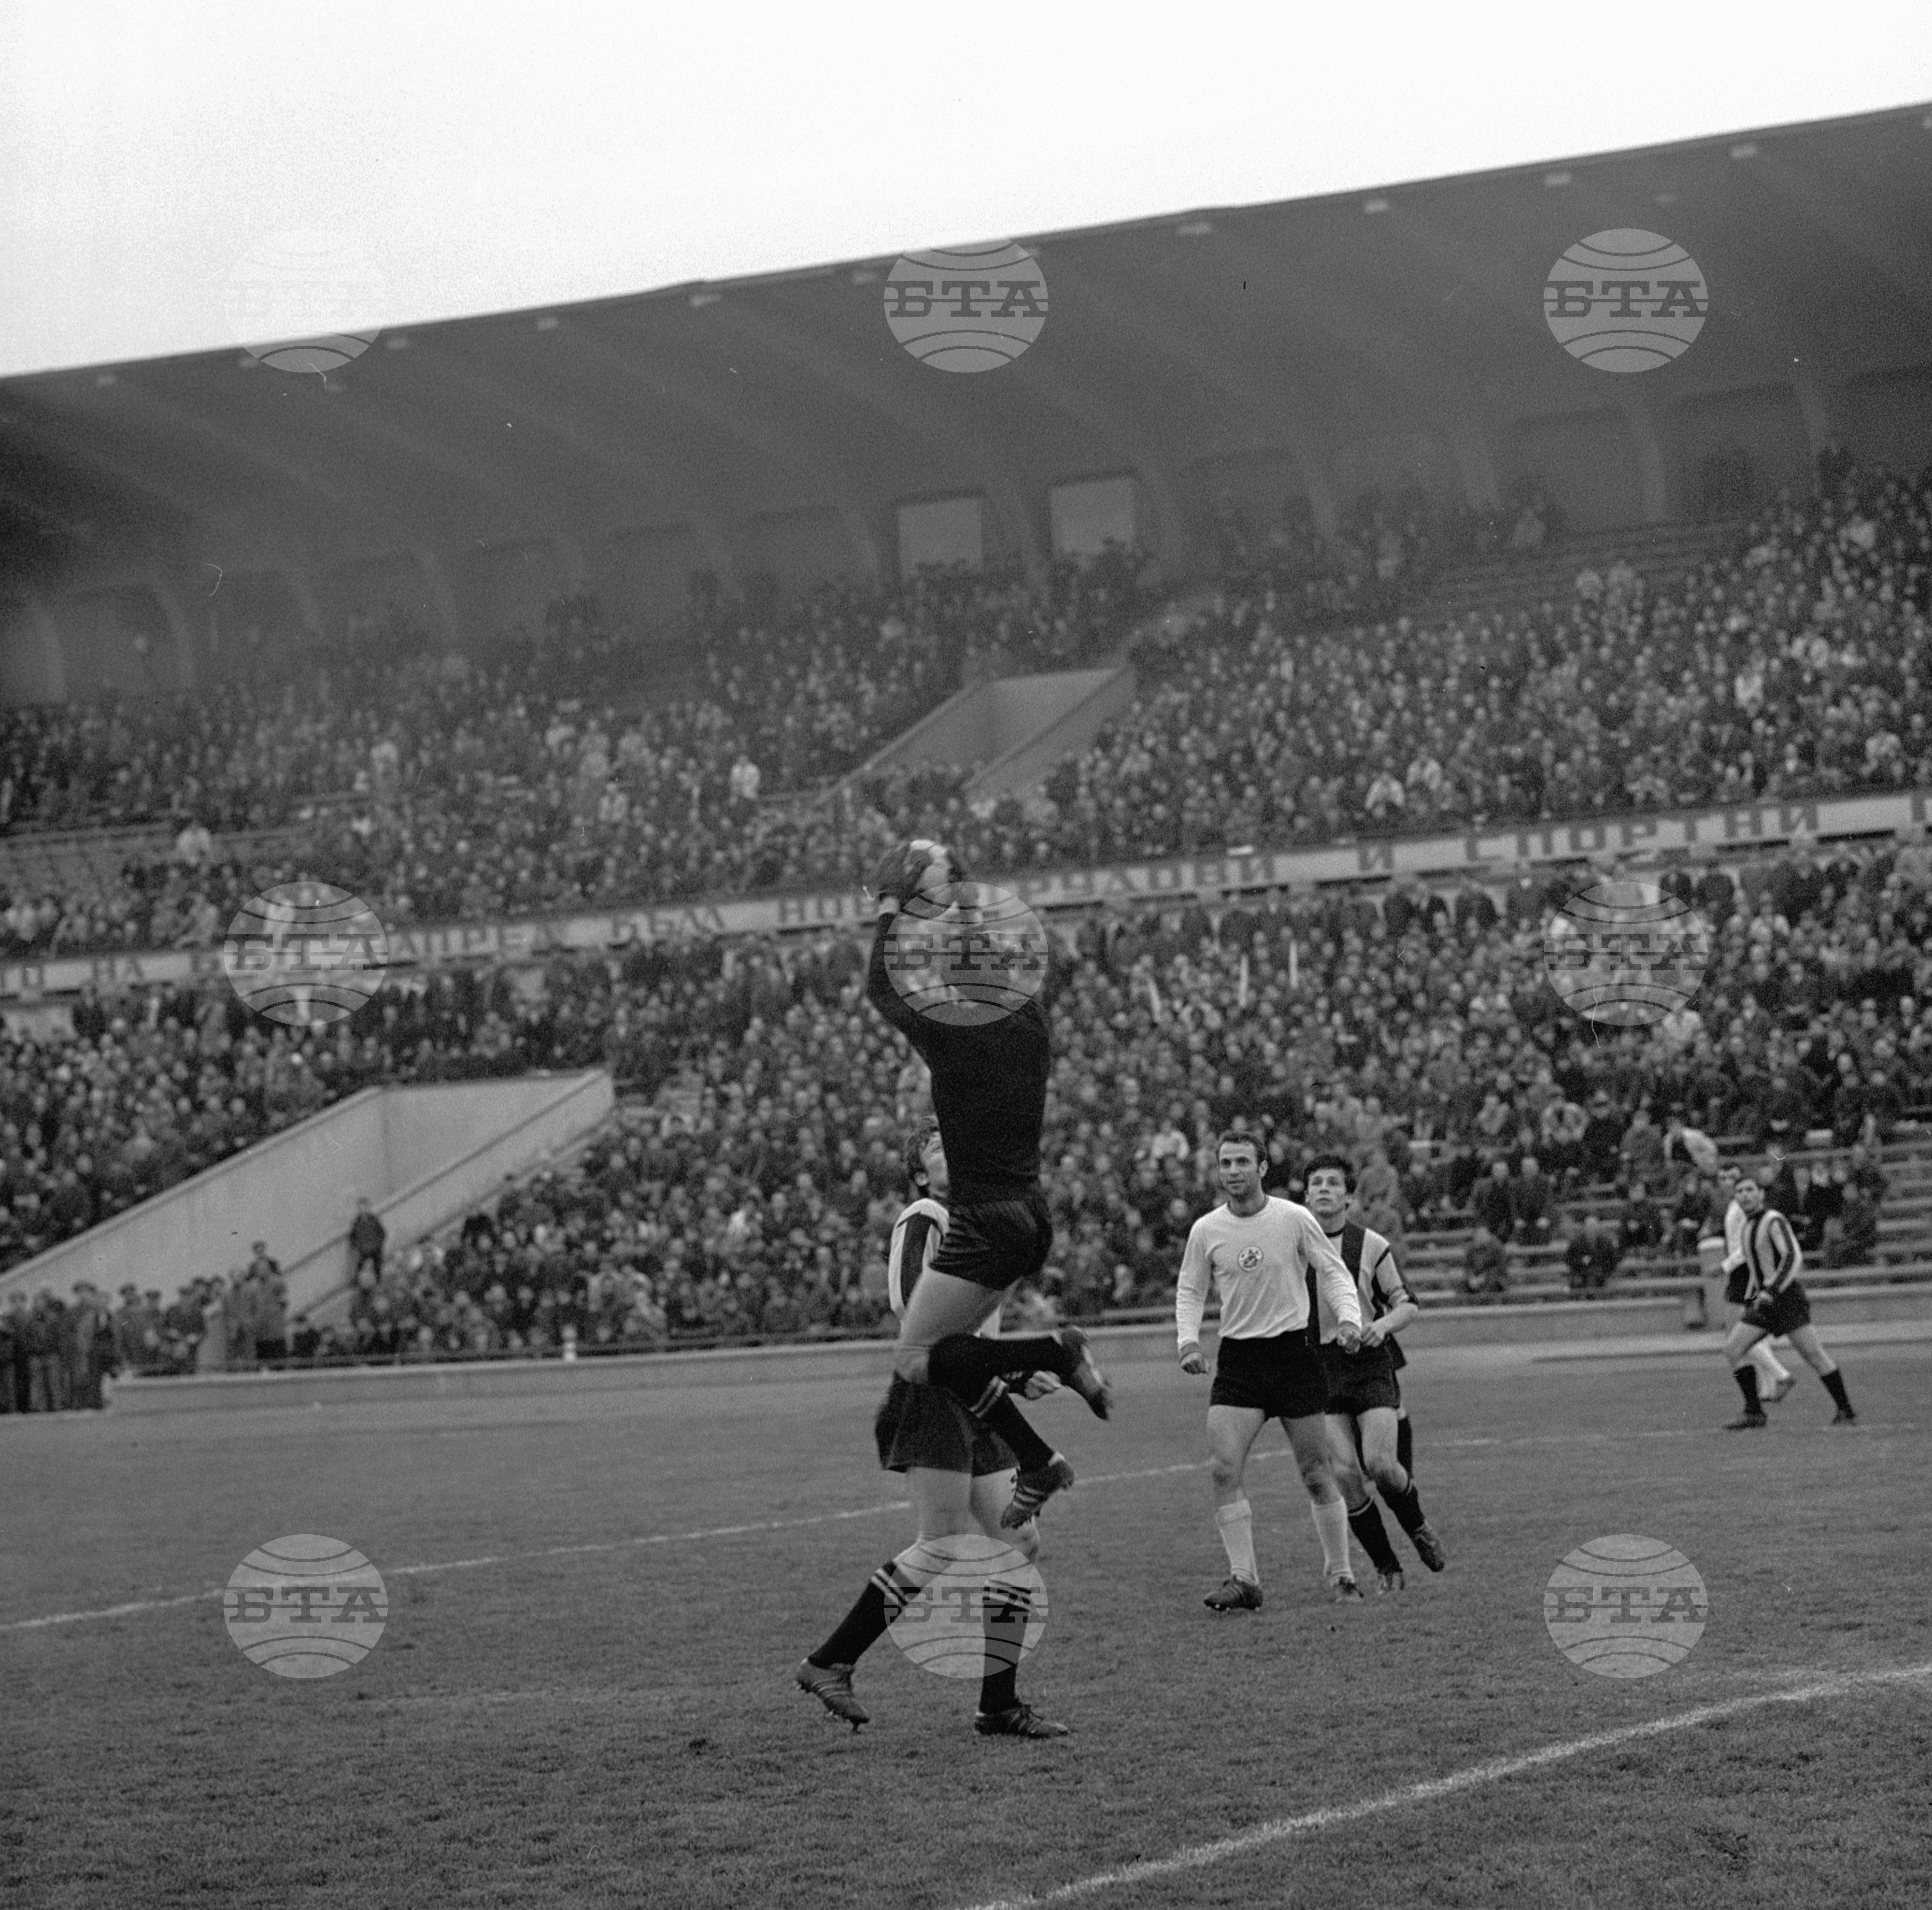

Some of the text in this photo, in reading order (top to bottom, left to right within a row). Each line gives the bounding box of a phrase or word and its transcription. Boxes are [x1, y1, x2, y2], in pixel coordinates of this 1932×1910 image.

[779, 894, 882, 923] НОВ
[1358, 842, 1393, 872] И
[1465, 803, 1818, 862] СПОРТНИ
